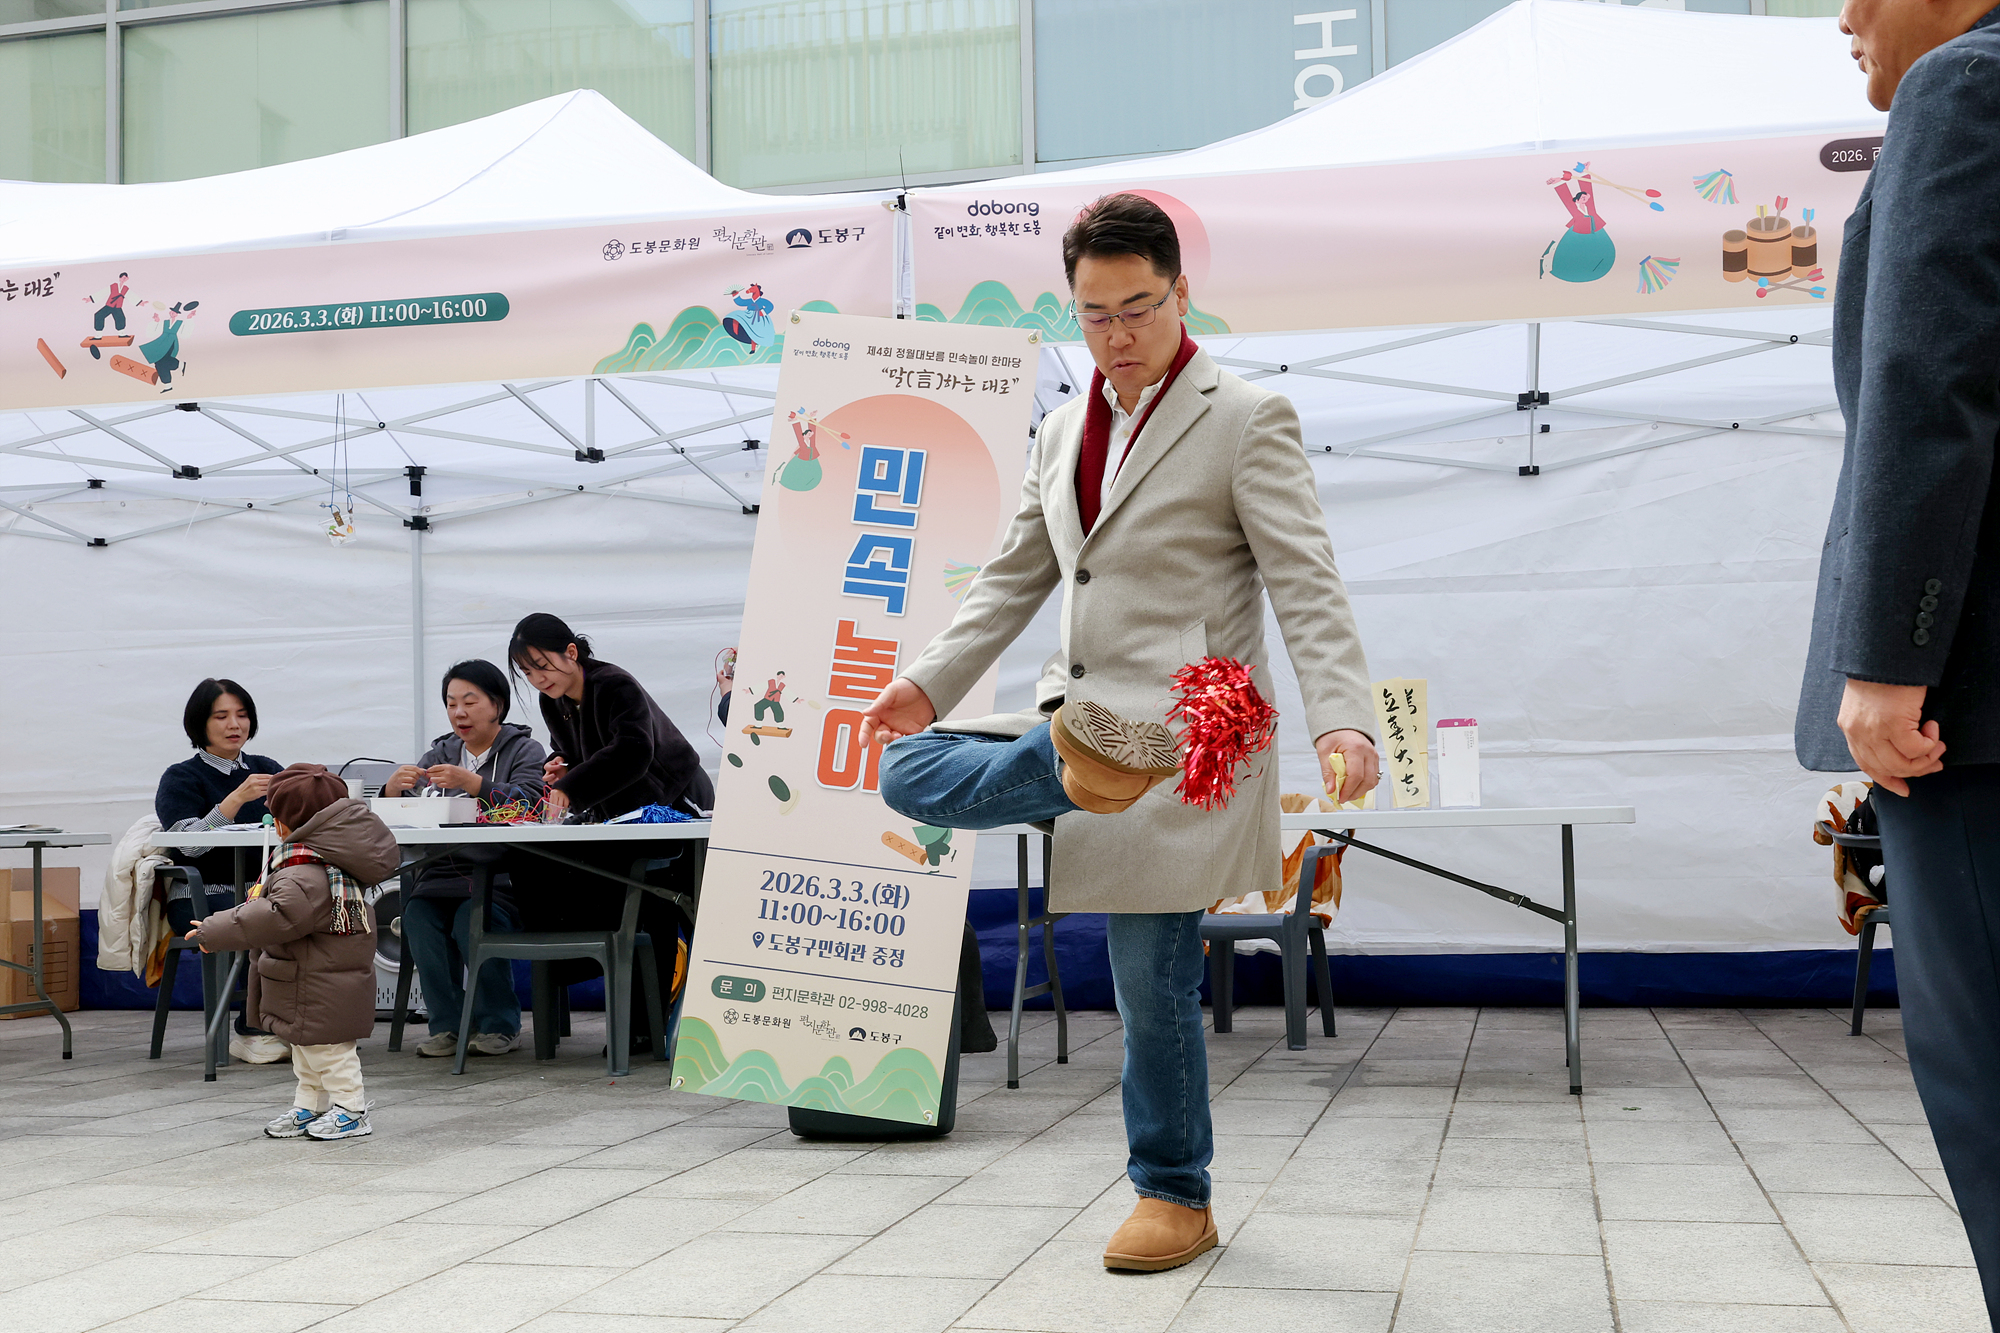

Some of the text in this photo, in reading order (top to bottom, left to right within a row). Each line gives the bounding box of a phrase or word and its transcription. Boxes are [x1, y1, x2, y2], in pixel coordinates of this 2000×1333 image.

[1831, 149, 1867, 163] 2026.
[967, 199, 1040, 217] dobong
[712, 226, 767, 252] 편지문학관
[818, 227, 866, 244] 도봉구
[934, 226, 954, 240] 같이
[985, 221, 1020, 237] 행복한
[1023, 219, 1042, 236] 도봉
[629, 237, 701, 255] 도봉문화원
[248, 298, 488, 331] 2026.3.3.(화) 11:00~16:00
[812, 337, 851, 352] dobong
[866, 345, 1022, 369] 제4회 정월대보름 민속놀이 한마당
[814, 443, 927, 795] 민속놀이
[760, 869, 910, 911] 2026.3.3.(화)
[757, 898, 906, 937] 11:00~16:00
[767, 933, 906, 968] 도봉구민회관 중정
[772, 985, 836, 1008] 편지문학관
[838, 995, 929, 1019] 02-998-4028
[741, 1013, 792, 1029] 도봉문화원
[869, 1031, 902, 1045] 도봉구
